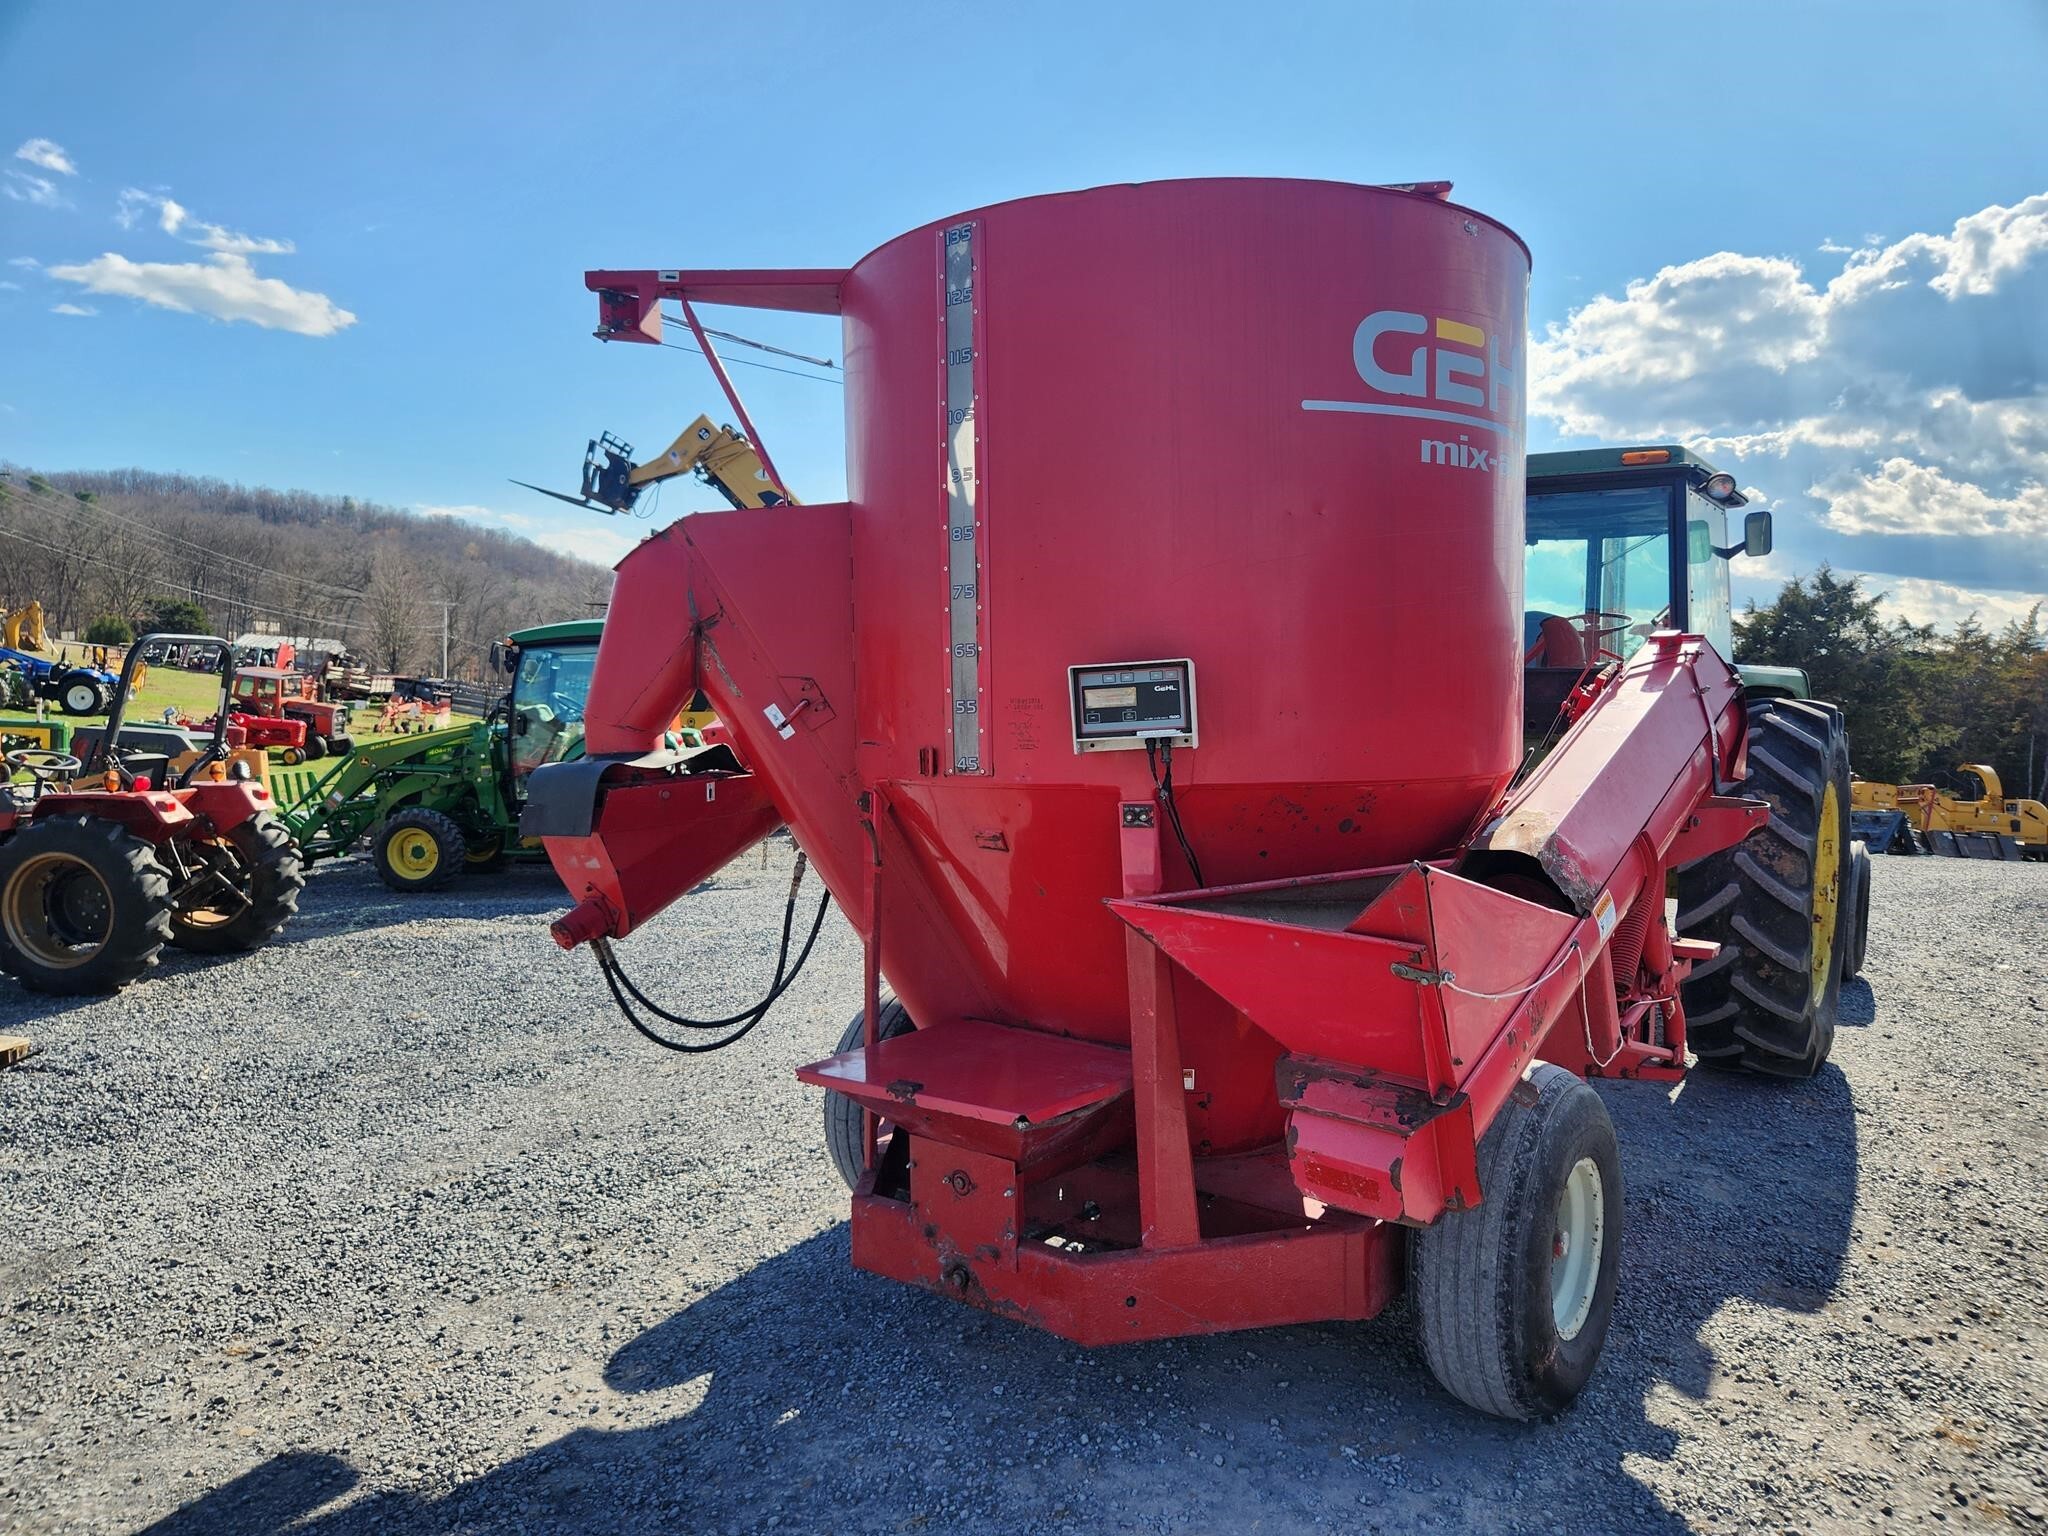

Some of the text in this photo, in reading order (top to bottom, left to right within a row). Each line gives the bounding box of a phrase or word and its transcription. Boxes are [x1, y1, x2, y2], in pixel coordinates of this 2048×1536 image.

[945, 225, 972, 247] 135
[946, 287, 973, 307] 125
[949, 347, 973, 366] 115
[948, 408, 975, 425] 105
[952, 467, 973, 483] 95
[952, 525, 975, 541] 85
[953, 584, 975, 600] 75
[954, 643, 976, 657] 65
[956, 700, 977, 713] 55
[957, 757, 979, 772] 45
